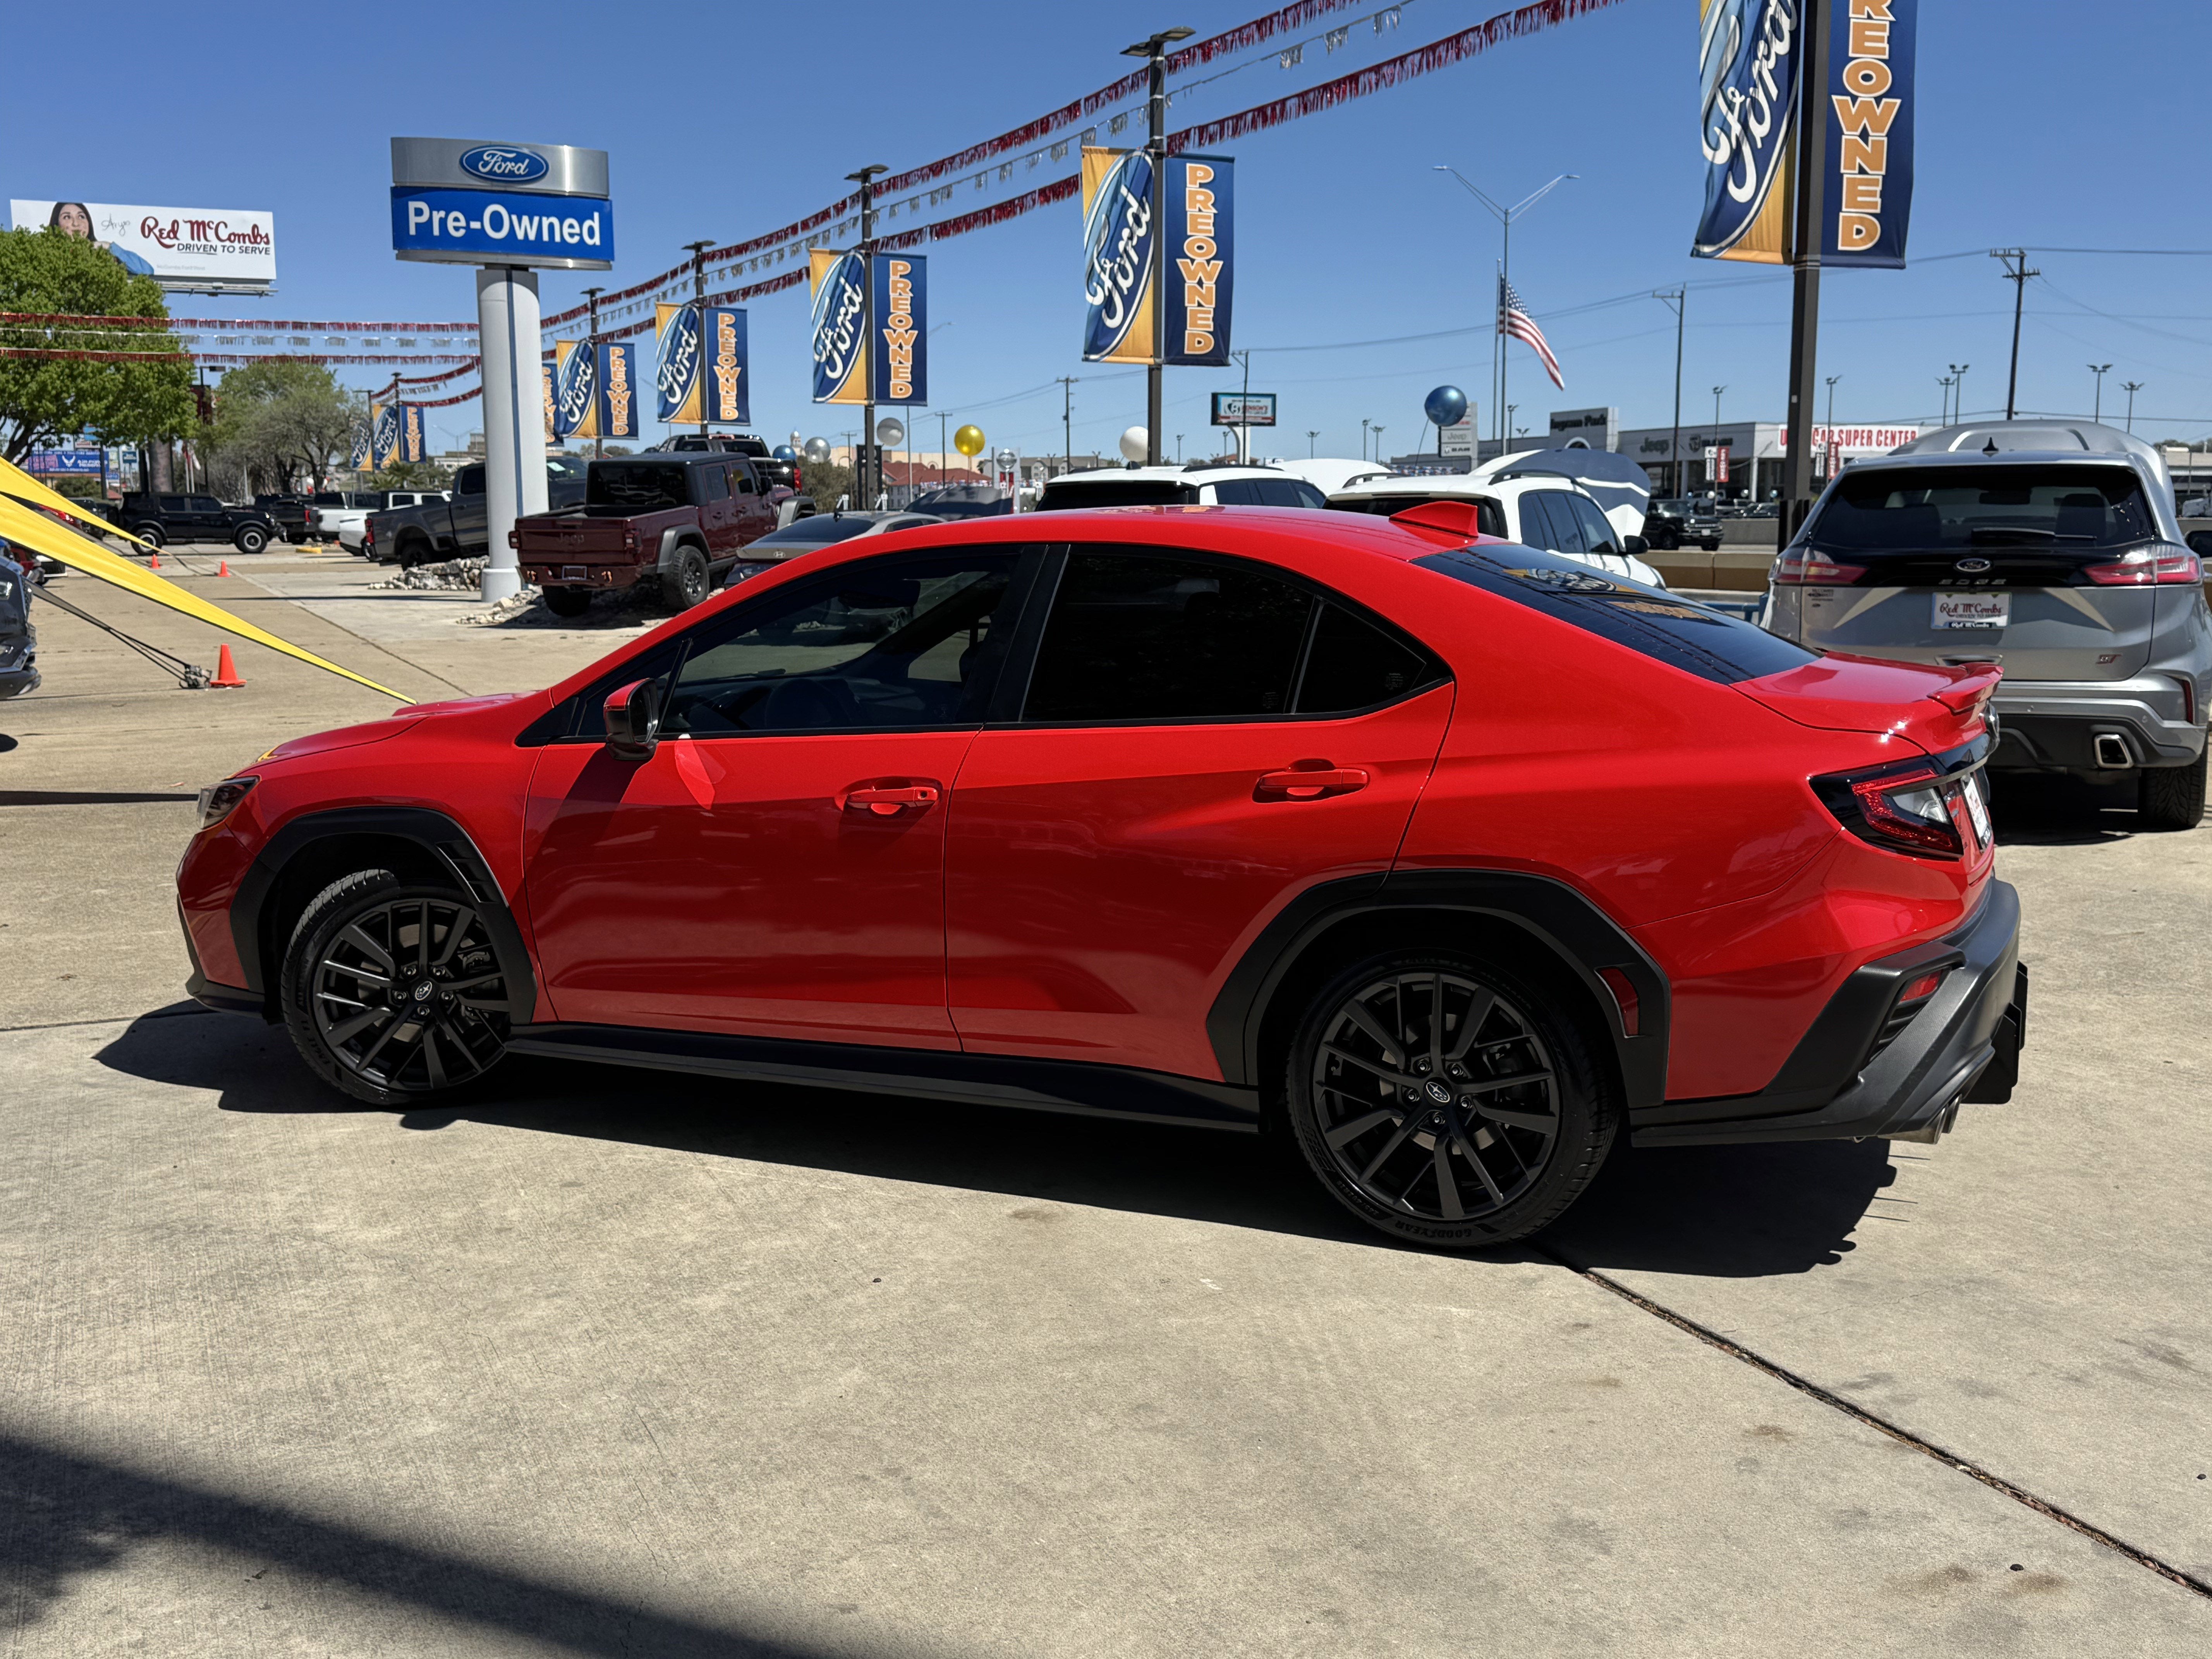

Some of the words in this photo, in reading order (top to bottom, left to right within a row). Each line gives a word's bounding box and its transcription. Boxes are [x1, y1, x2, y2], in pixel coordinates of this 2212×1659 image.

[1701, 0, 1797, 203] Ford
[1831, 0, 1902, 251] REOWNED
[478, 150, 529, 175] Ford
[141, 216, 180, 249] Red
[183, 219, 270, 245] McCombs
[177, 243, 217, 252] DRIVEN
[221, 244, 235, 254] TO
[239, 246, 271, 255] SERVE
[408, 201, 600, 246] Pre-Owned
[1085, 184, 1151, 328] Ford
[1176, 163, 1223, 354] PREOWNED
[658, 323, 697, 404] Ford
[813, 276, 863, 379] Ford
[883, 260, 918, 398] PREOWNED
[559, 356, 593, 423] Ford
[606, 347, 631, 435] PREOWNED
[713, 313, 741, 420] PREOWNED
[374, 414, 396, 454] Ford
[1640, 437, 1669, 455] Jeep
[1838, 429, 1873, 446] SUPER
[1940, 602, 1959, 617] Red
[1960, 603, 2002, 613] McCombs
